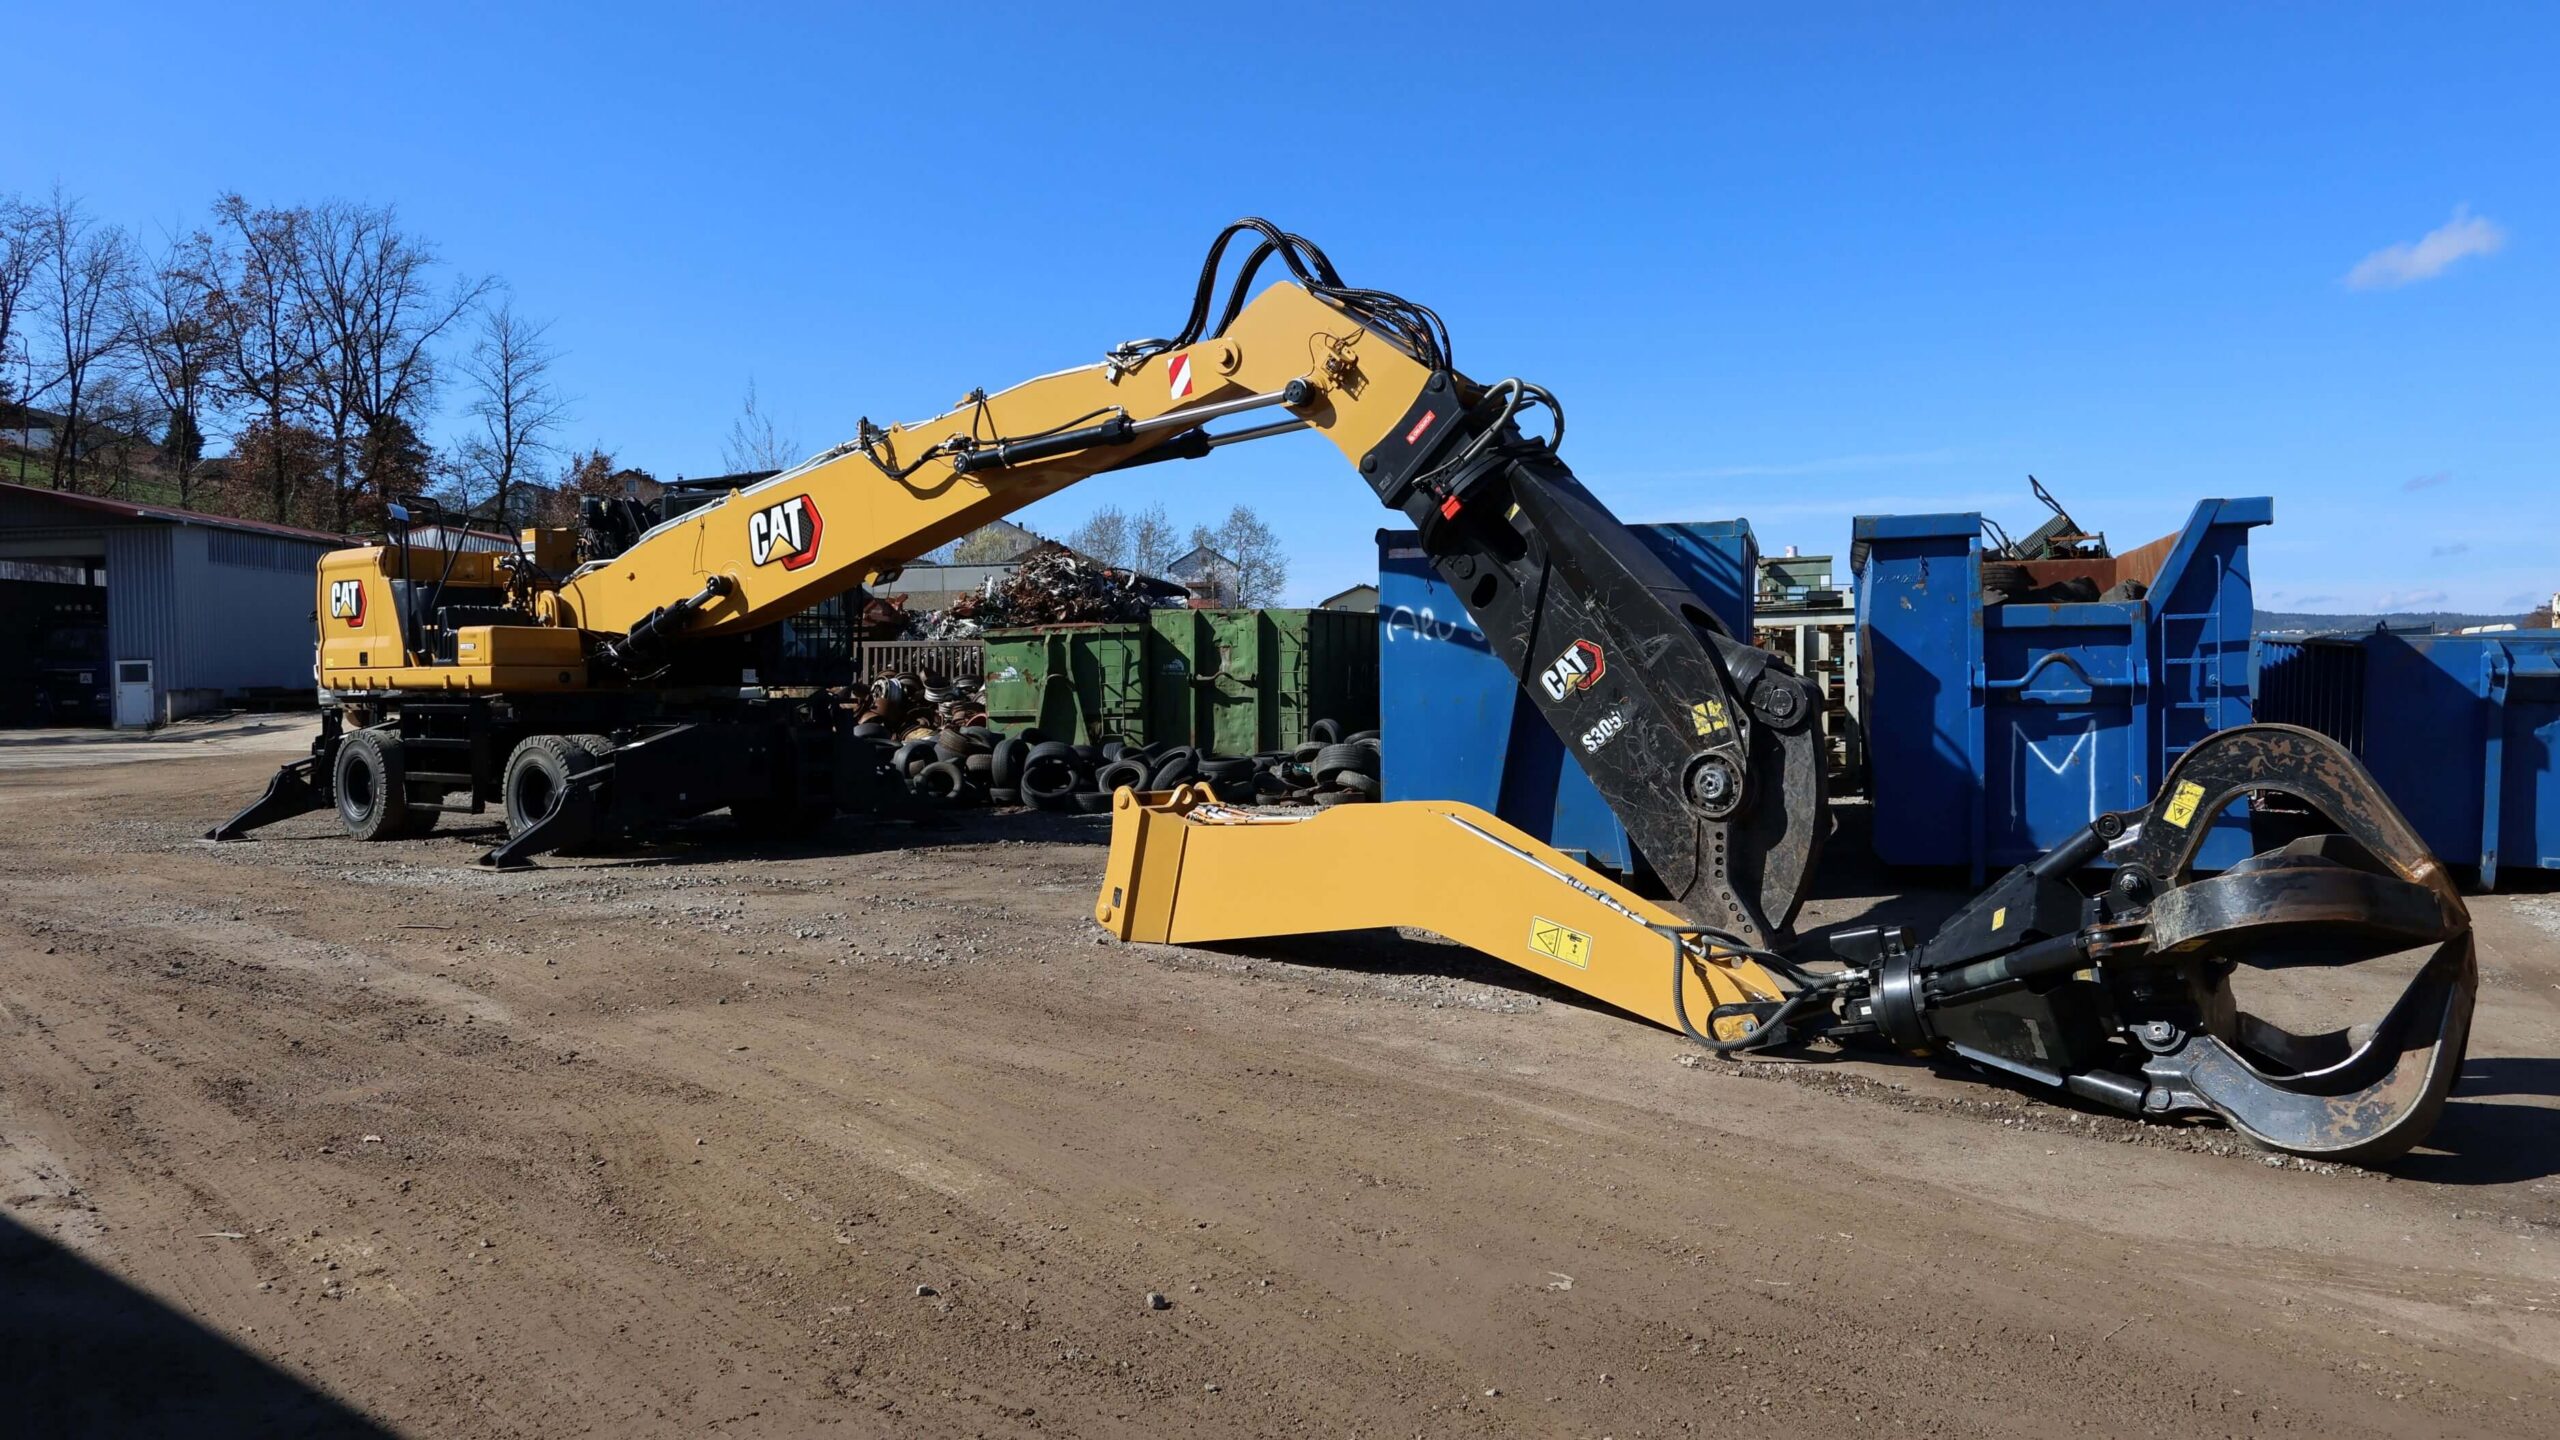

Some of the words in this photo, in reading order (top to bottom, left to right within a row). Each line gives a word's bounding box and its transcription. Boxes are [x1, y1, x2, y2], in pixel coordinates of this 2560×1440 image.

[749, 496, 803, 566] CAT
[331, 580, 360, 618] CAT
[1541, 644, 1589, 701] CAT
[2011, 719, 2097, 832] M
